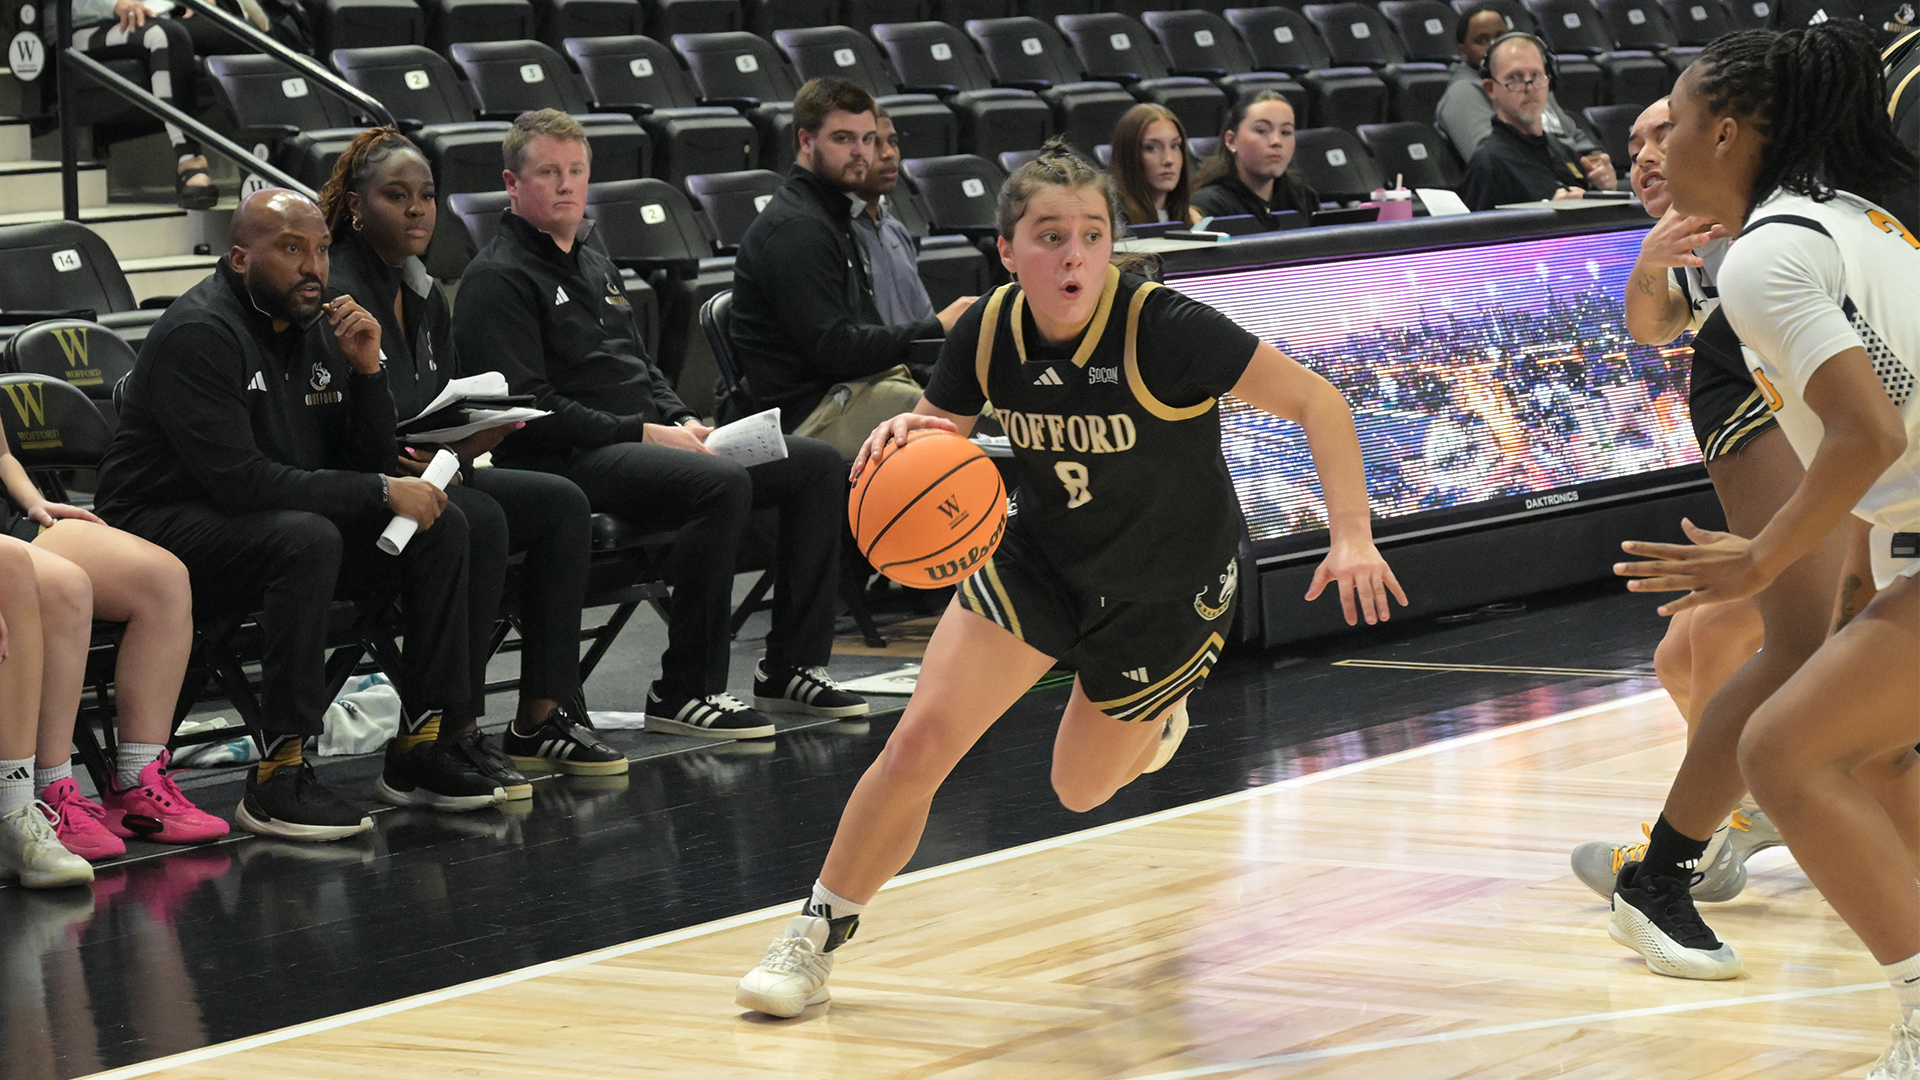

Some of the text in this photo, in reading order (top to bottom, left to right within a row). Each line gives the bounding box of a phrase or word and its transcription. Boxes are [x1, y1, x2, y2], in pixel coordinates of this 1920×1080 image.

[17, 40, 36, 62] W
[57, 254, 74, 267] 14
[51, 327, 88, 367] W
[65, 368, 102, 379] WOFFORD
[1, 382, 45, 428] W
[17, 429, 60, 441] WOFFORD
[1053, 461, 1094, 509] 8
[936, 494, 961, 519] W
[1525, 491, 1579, 509] DAKTRONICS
[924, 513, 1007, 581] Wilson
